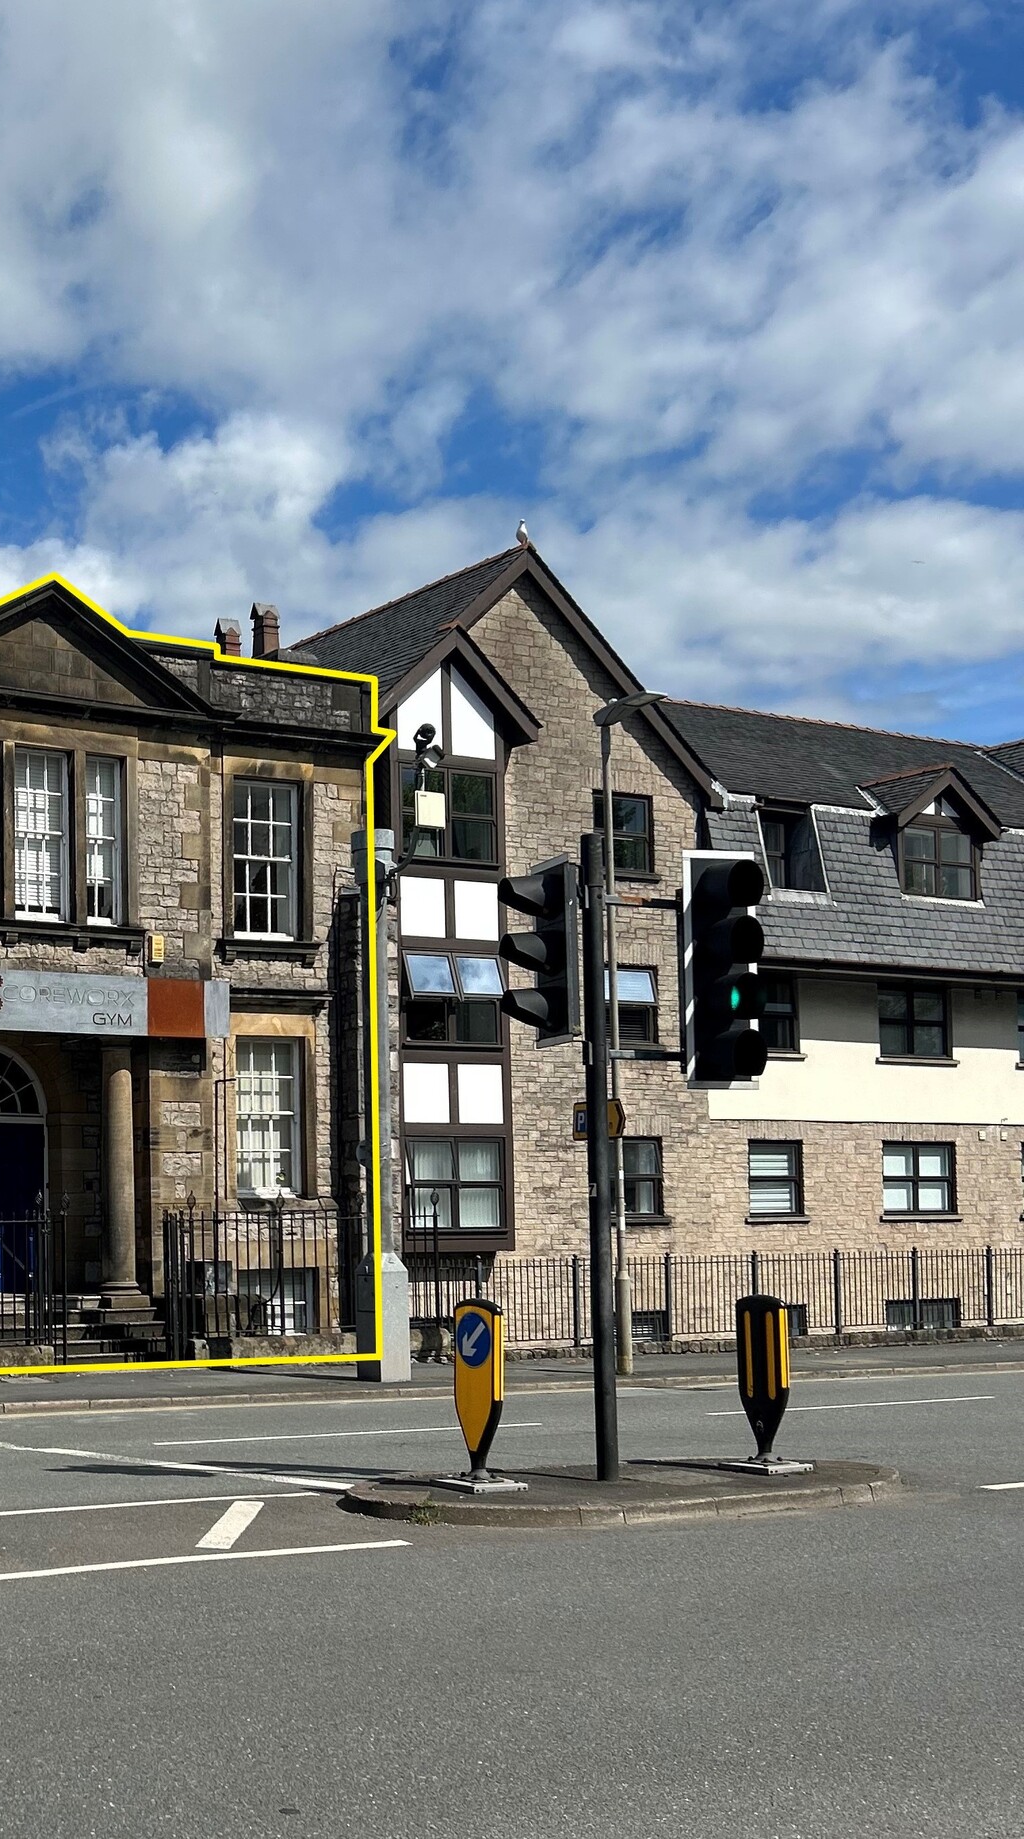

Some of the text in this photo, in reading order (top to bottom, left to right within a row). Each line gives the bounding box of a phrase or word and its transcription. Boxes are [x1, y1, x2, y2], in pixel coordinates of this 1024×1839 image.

[2, 984, 135, 1007] COREWORX
[92, 1012, 132, 1027] GYM
[578, 1112, 585, 1131] P
